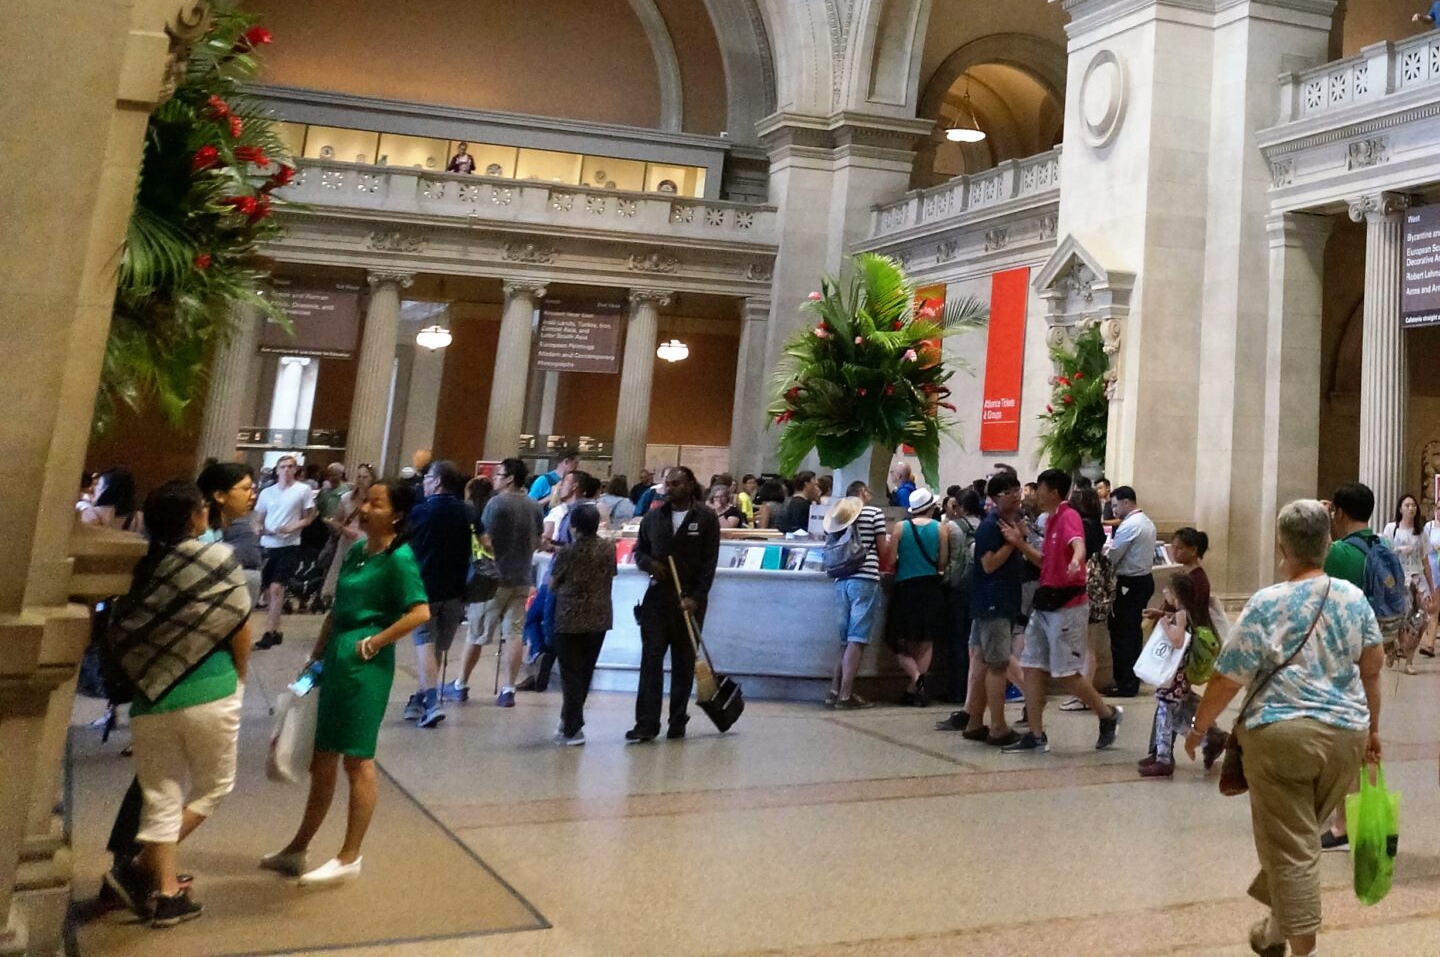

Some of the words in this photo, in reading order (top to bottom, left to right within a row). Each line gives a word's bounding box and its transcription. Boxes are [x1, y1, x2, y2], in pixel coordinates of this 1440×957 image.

[1407, 232, 1432, 242] Byzantine
[1407, 246, 1431, 256] European
[1406, 256, 1433, 266] Decorative
[1406, 271, 1424, 281] Robert
[1406, 287, 1420, 295] Arms
[1421, 285, 1431, 294] and
